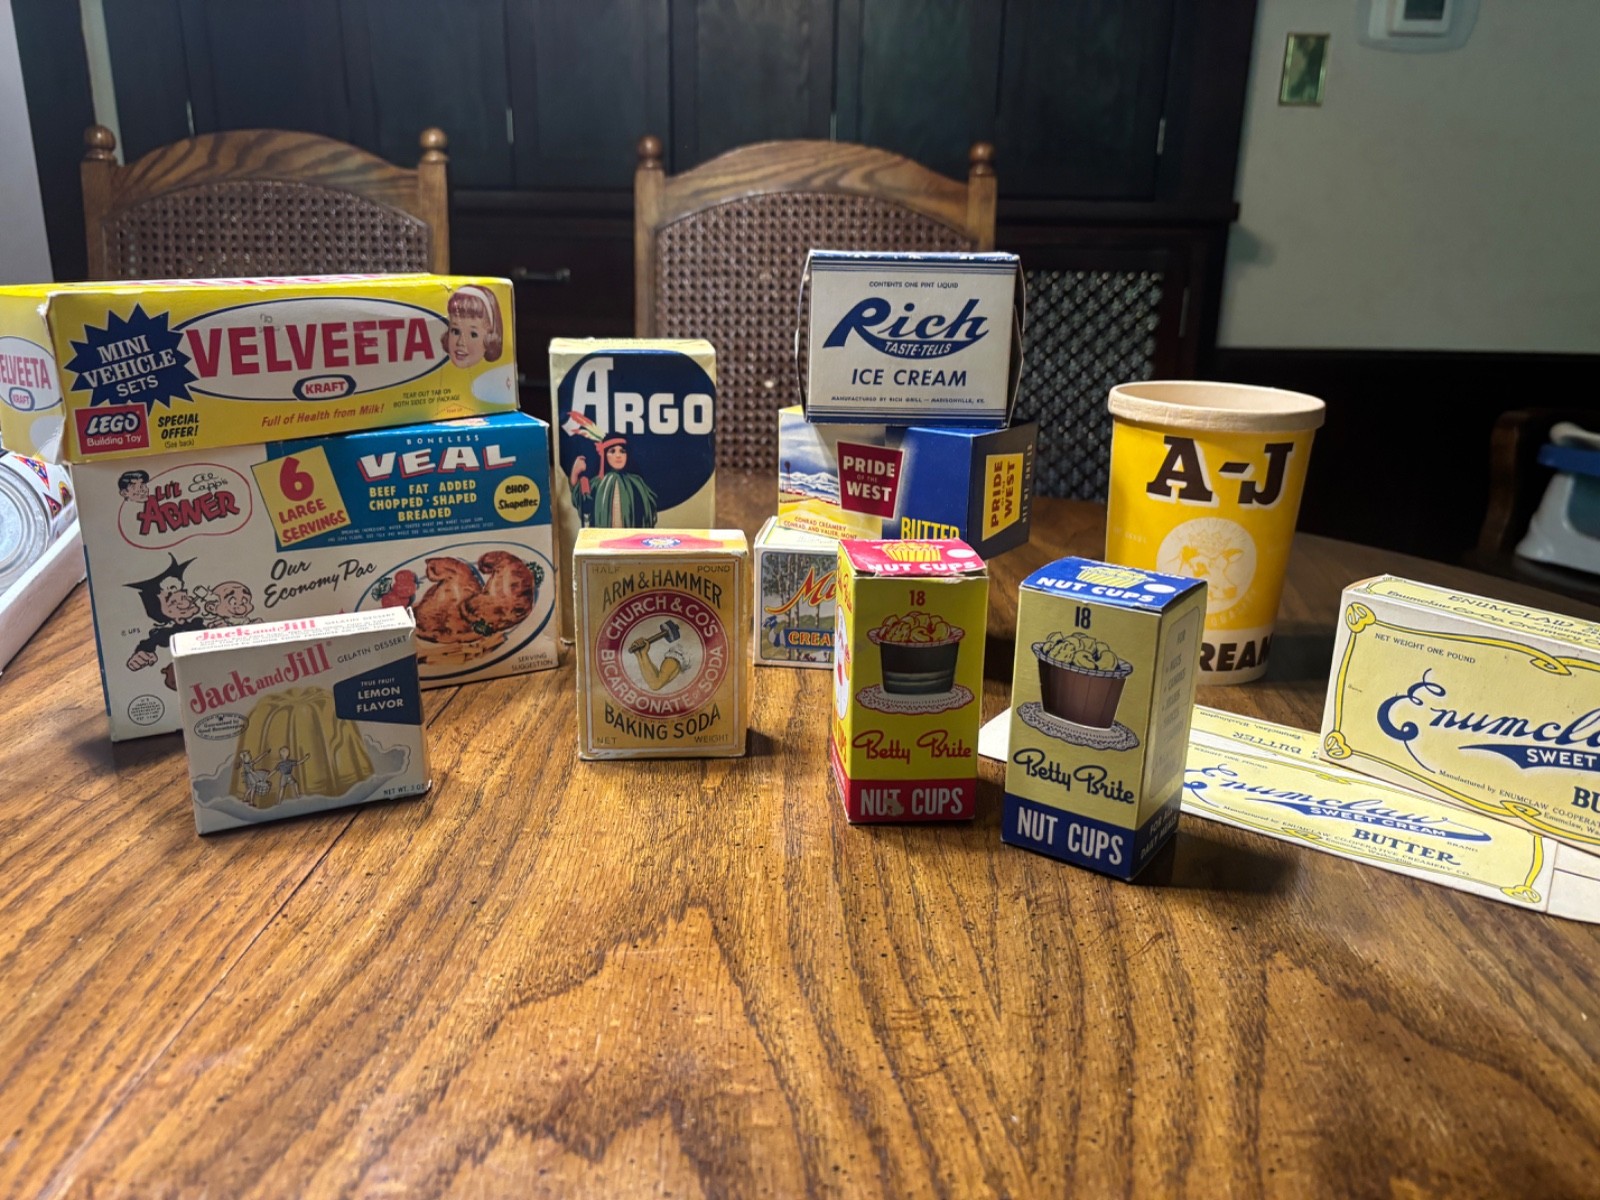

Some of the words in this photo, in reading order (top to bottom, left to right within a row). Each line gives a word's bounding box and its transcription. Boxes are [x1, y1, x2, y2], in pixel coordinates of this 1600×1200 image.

[868, 281, 902, 289] CONTENTS
[822, 296, 989, 351] Rich
[97, 335, 150, 364] MINI
[186, 317, 436, 378] VELVEETA
[0, 353, 52, 389] ELVEETA
[82, 348, 177, 389] VEHICLE
[851, 368, 885, 386] ICE
[893, 368, 967, 387] CREAM
[116, 374, 159, 397] SETS
[305, 381, 346, 394] KRAFT
[562, 357, 713, 436] ARGO
[85, 412, 140, 436] LEGO
[158, 413, 199, 428] SPECIAL
[261, 415, 280, 428] Full
[283, 414, 293, 425] of
[297, 410, 330, 424] Health
[333, 406, 358, 420] from
[359, 403, 386, 416] Milk!
[86, 436, 123, 447] Building
[125, 433, 142, 444] Toy
[161, 425, 199, 439] OFFER!
[406, 435, 480, 445] BONELESS
[358, 444, 517, 482] VEAL
[842, 455, 896, 478] PRIDE
[279, 457, 315, 502] 6
[369, 486, 397, 498] BEEF
[408, 484, 429, 495] FAT
[439, 480, 477, 493] ADDED
[505, 484, 530, 494] CHOP
[846, 480, 892, 502] WEST
[1004, 461, 1015, 519] WEST
[369, 496, 423, 511] CHOPPED
[433, 493, 477, 506] SHAPED
[991, 461, 1003, 528] PRIDE
[137, 490, 240, 535] ABNER
[278, 498, 327, 525] LARGE
[398, 507, 452, 522] BREADED
[794, 516, 817, 526] CONRAD
[819, 521, 847, 531] CREAMERY
[282, 510, 347, 543] SERVINGS
[271, 559, 312, 581] Our
[592, 566, 621, 574] HALF
[697, 565, 731, 573] POUND
[867, 562, 912, 572] NUT
[919, 561, 977, 571] CUPS
[264, 573, 340, 608] Economy
[338, 559, 377, 581] Pac
[602, 574, 635, 612] ARM
[637, 571, 649, 589] &
[651, 569, 723, 609] HAMMER
[1036, 577, 1087, 591] NUT
[1091, 585, 1156, 603] CUPS
[909, 590, 926, 606] 18
[606, 595, 667, 640] CHURCH
[670, 597, 683, 612] &
[1075, 606, 1091, 630] 18
[337, 647, 371, 663] GELATIN
[374, 635, 408, 652] DESSERT
[788, 631, 835, 646] CREA
[1375, 632, 1390, 642] NET
[1393, 635, 1425, 651] WEIGHT
[1427, 646, 1444, 656] ONE
[1447, 650, 1476, 664] POUND
[512, 659, 553, 671] SUGGESTION
[518, 652, 547, 662] SERVING
[190, 670, 257, 714] Jack
[256, 668, 284, 690] and
[284, 642, 333, 682] Jill
[601, 650, 695, 714] BICARBONATE
[699, 645, 724, 694] SODA
[356, 698, 404, 713] FLAVOR
[357, 686, 401, 700] LEMON
[604, 702, 668, 741] BAKING
[673, 703, 721, 739] SODA
[597, 737, 617, 745] NET
[694, 734, 729, 743] WEIGHT
[852, 729, 911, 765] Betty
[916, 729, 972, 758] Brite
[1526, 748, 1598, 768] SWEET
[1013, 748, 1071, 791] Betty
[1073, 764, 1135, 805] Brite
[860, 788, 902, 817] NUT
[911, 787, 963, 814] CUPS
[1438, 769, 1486, 790] Manufactured
[1487, 782, 1496, 794] by
[1499, 789, 1549, 811] ENUMCLAW
[1309, 807, 1376, 823] SWEET
[1382, 819, 1447, 837] CREAM
[1017, 806, 1059, 845] NUT
[1067, 822, 1124, 866] CUPS
[1352, 828, 1462, 866] BUTTER
[1446, 841, 1479, 853] BRAND
